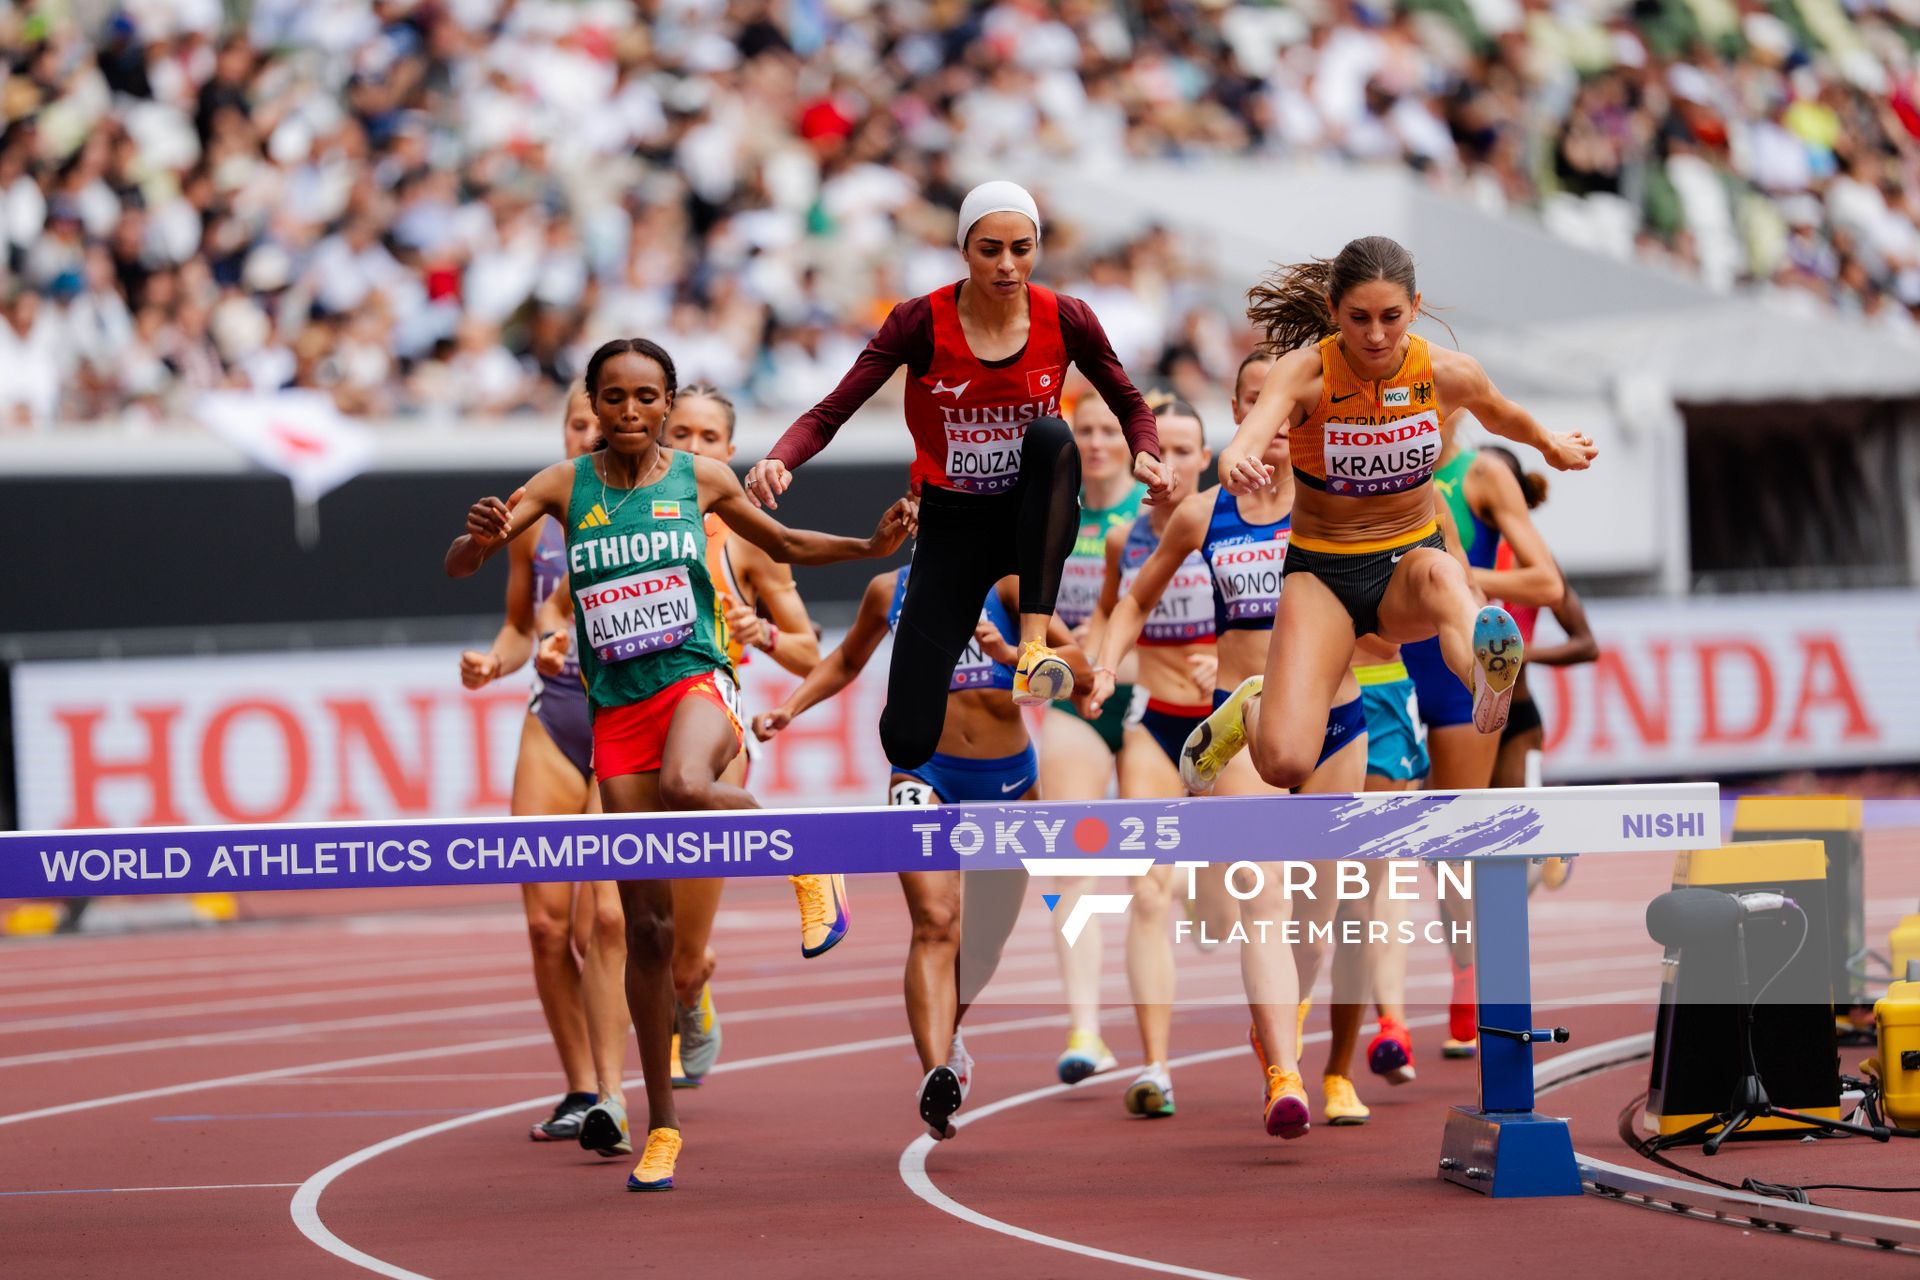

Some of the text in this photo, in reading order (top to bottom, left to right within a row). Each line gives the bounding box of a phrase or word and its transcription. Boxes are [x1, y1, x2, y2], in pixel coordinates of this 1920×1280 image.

[1384, 391, 1409, 402] WGV
[1327, 420, 1437, 447] HONDA
[1332, 444, 1435, 477] KRAUSE
[571, 531, 698, 574] ETHIOPIA
[581, 575, 687, 611] HONDA
[1239, 602, 1279, 613] TOK
[592, 598, 689, 644] ALMAYEW
[895, 787, 921, 805] 13
[1622, 812, 1704, 838] NISHI
[40, 829, 794, 882] WORLD ATHLETICS CHAMPIONSHIPS
